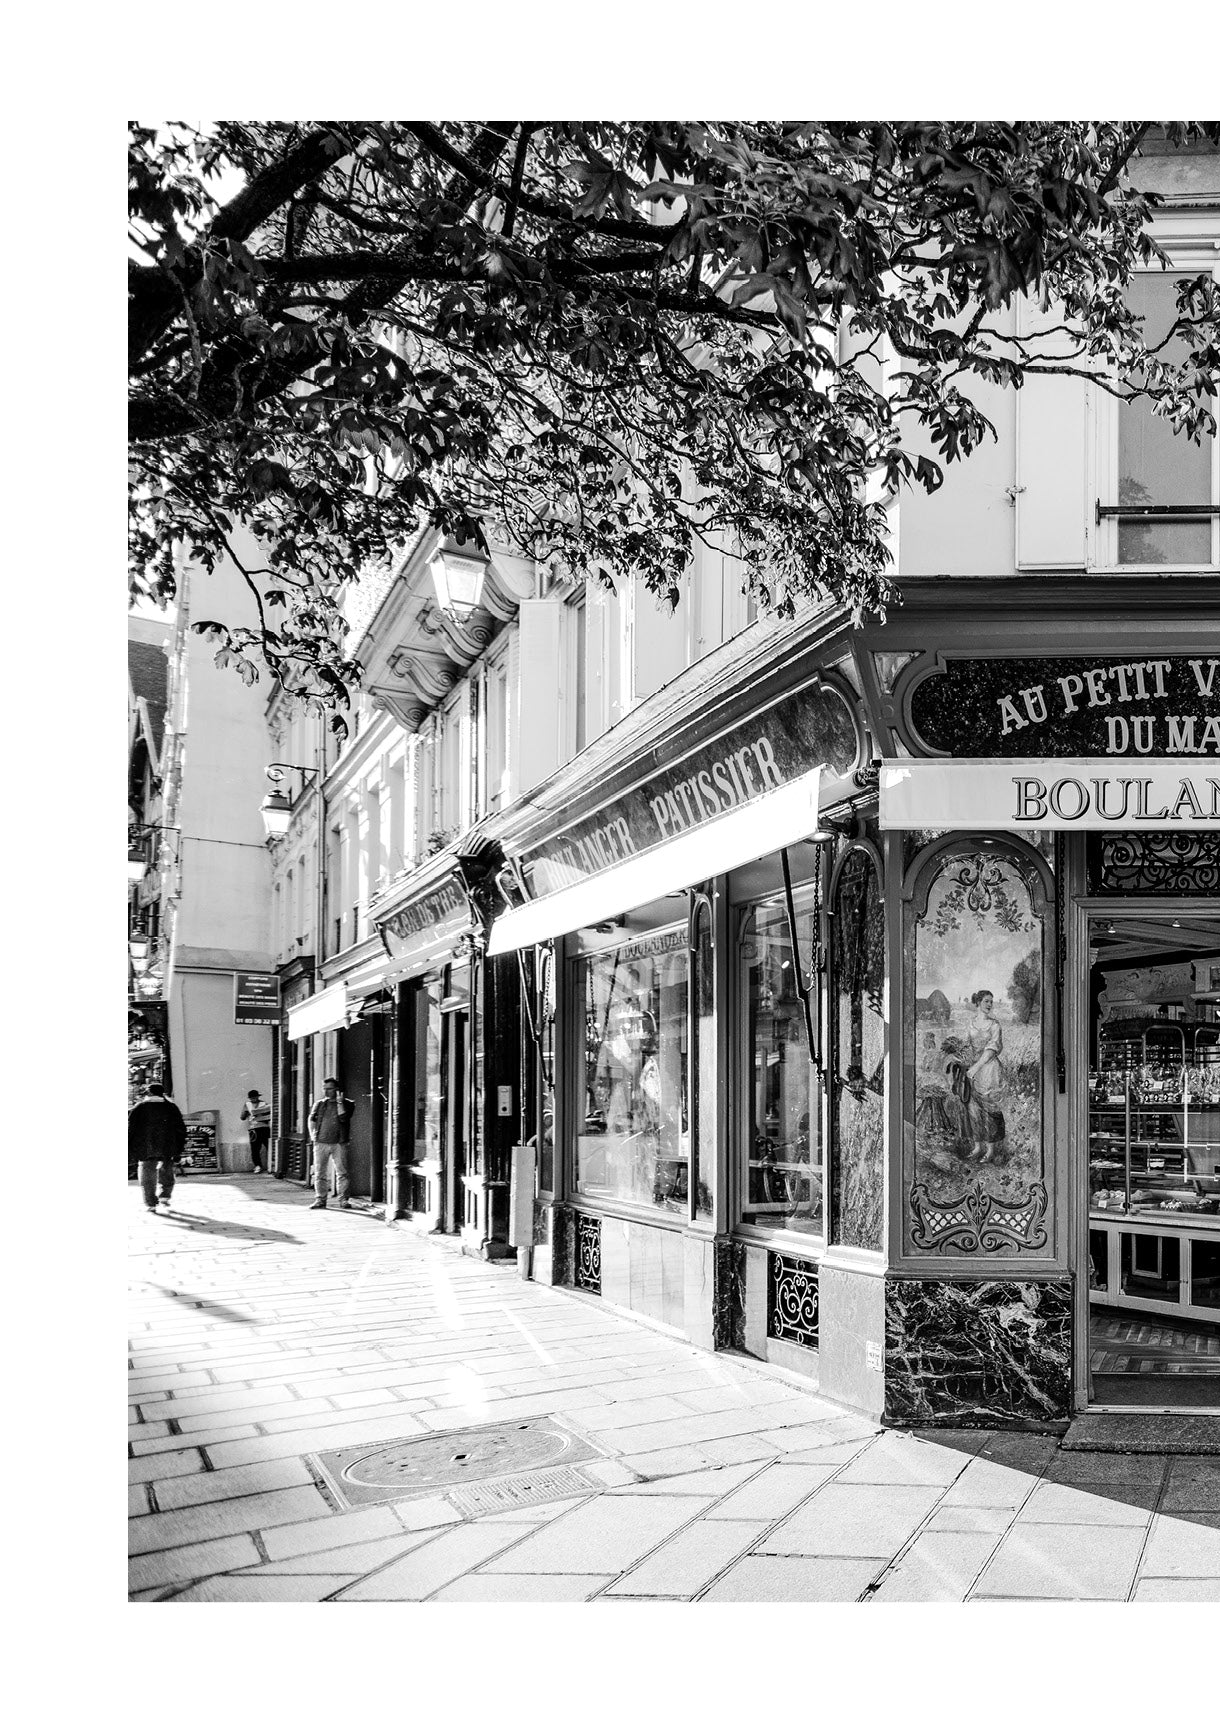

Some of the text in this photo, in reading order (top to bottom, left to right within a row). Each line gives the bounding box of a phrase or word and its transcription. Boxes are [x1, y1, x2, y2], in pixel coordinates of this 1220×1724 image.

[996, 685, 1048, 735] AU
[1056, 659, 1172, 713] PETIT
[1104, 716, 1157, 753] DU
[649, 737, 786, 840] PATISSIER
